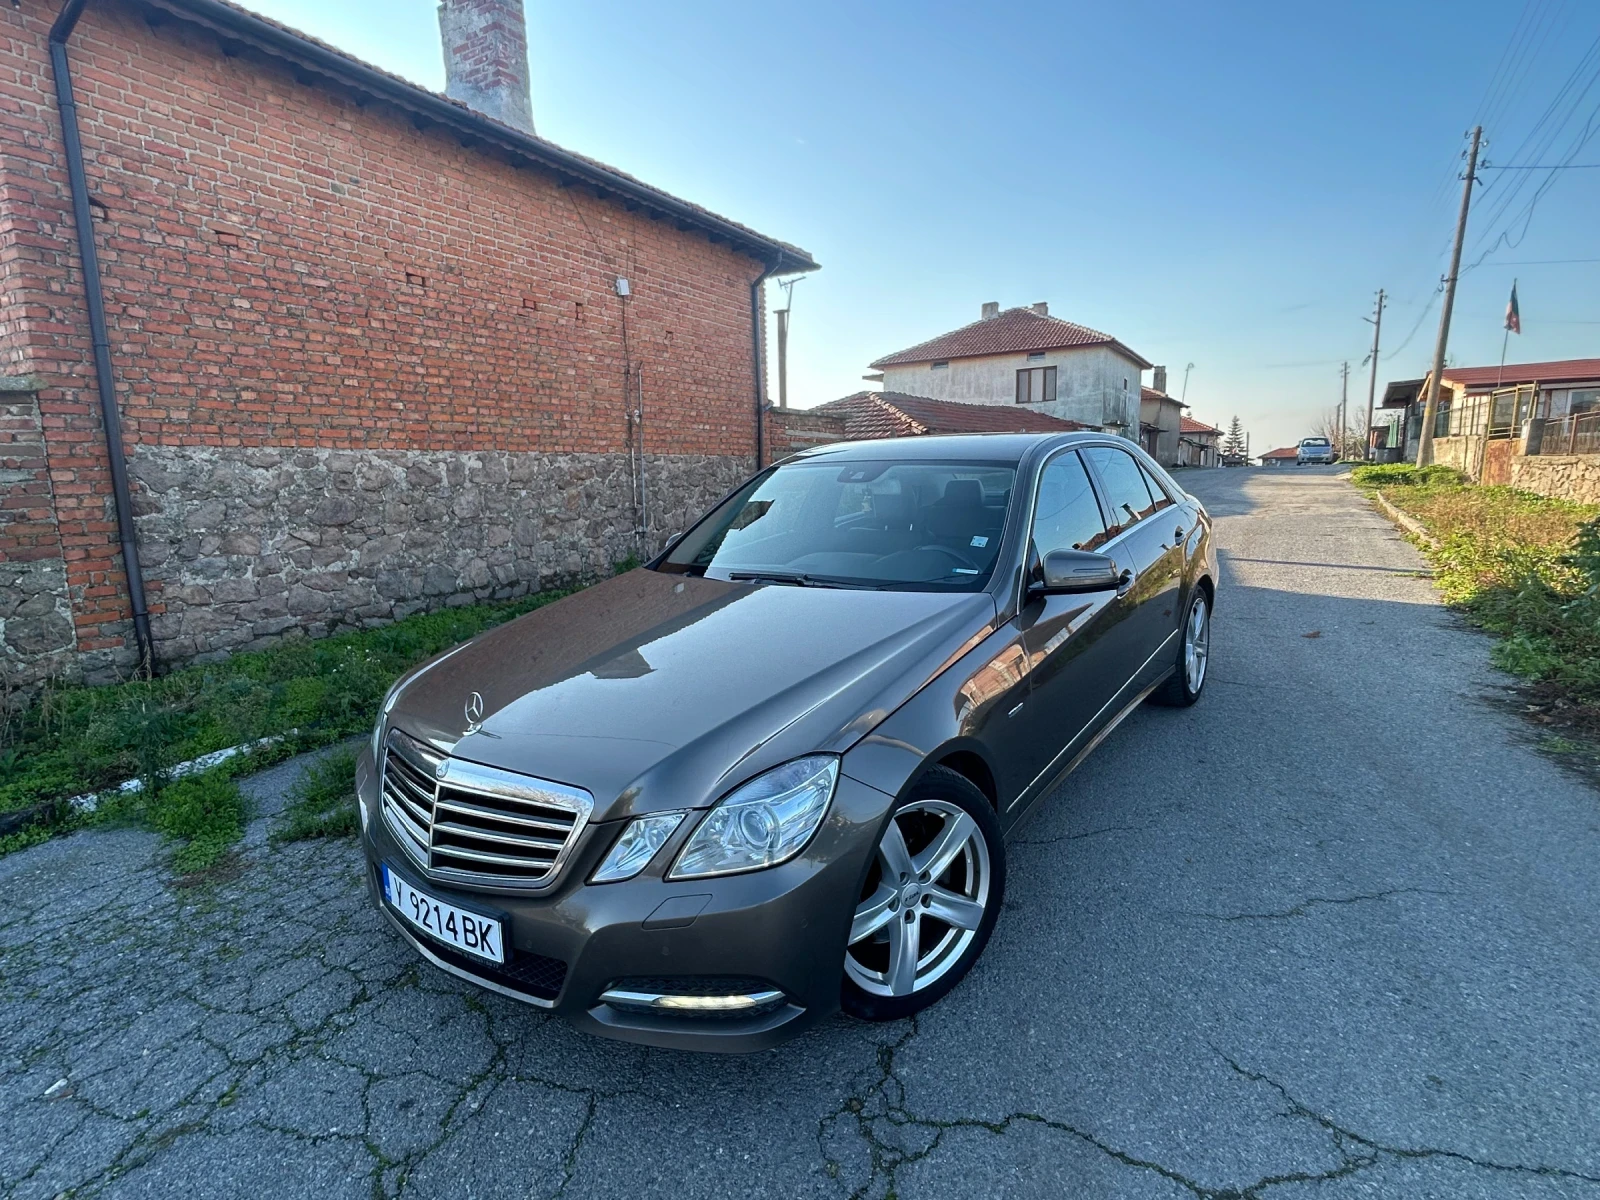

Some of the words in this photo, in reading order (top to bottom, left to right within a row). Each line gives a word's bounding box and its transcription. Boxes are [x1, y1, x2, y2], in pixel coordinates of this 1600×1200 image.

[394, 877, 402, 907] Y
[410, 891, 458, 942] 9214
[462, 915, 496, 956] BK
